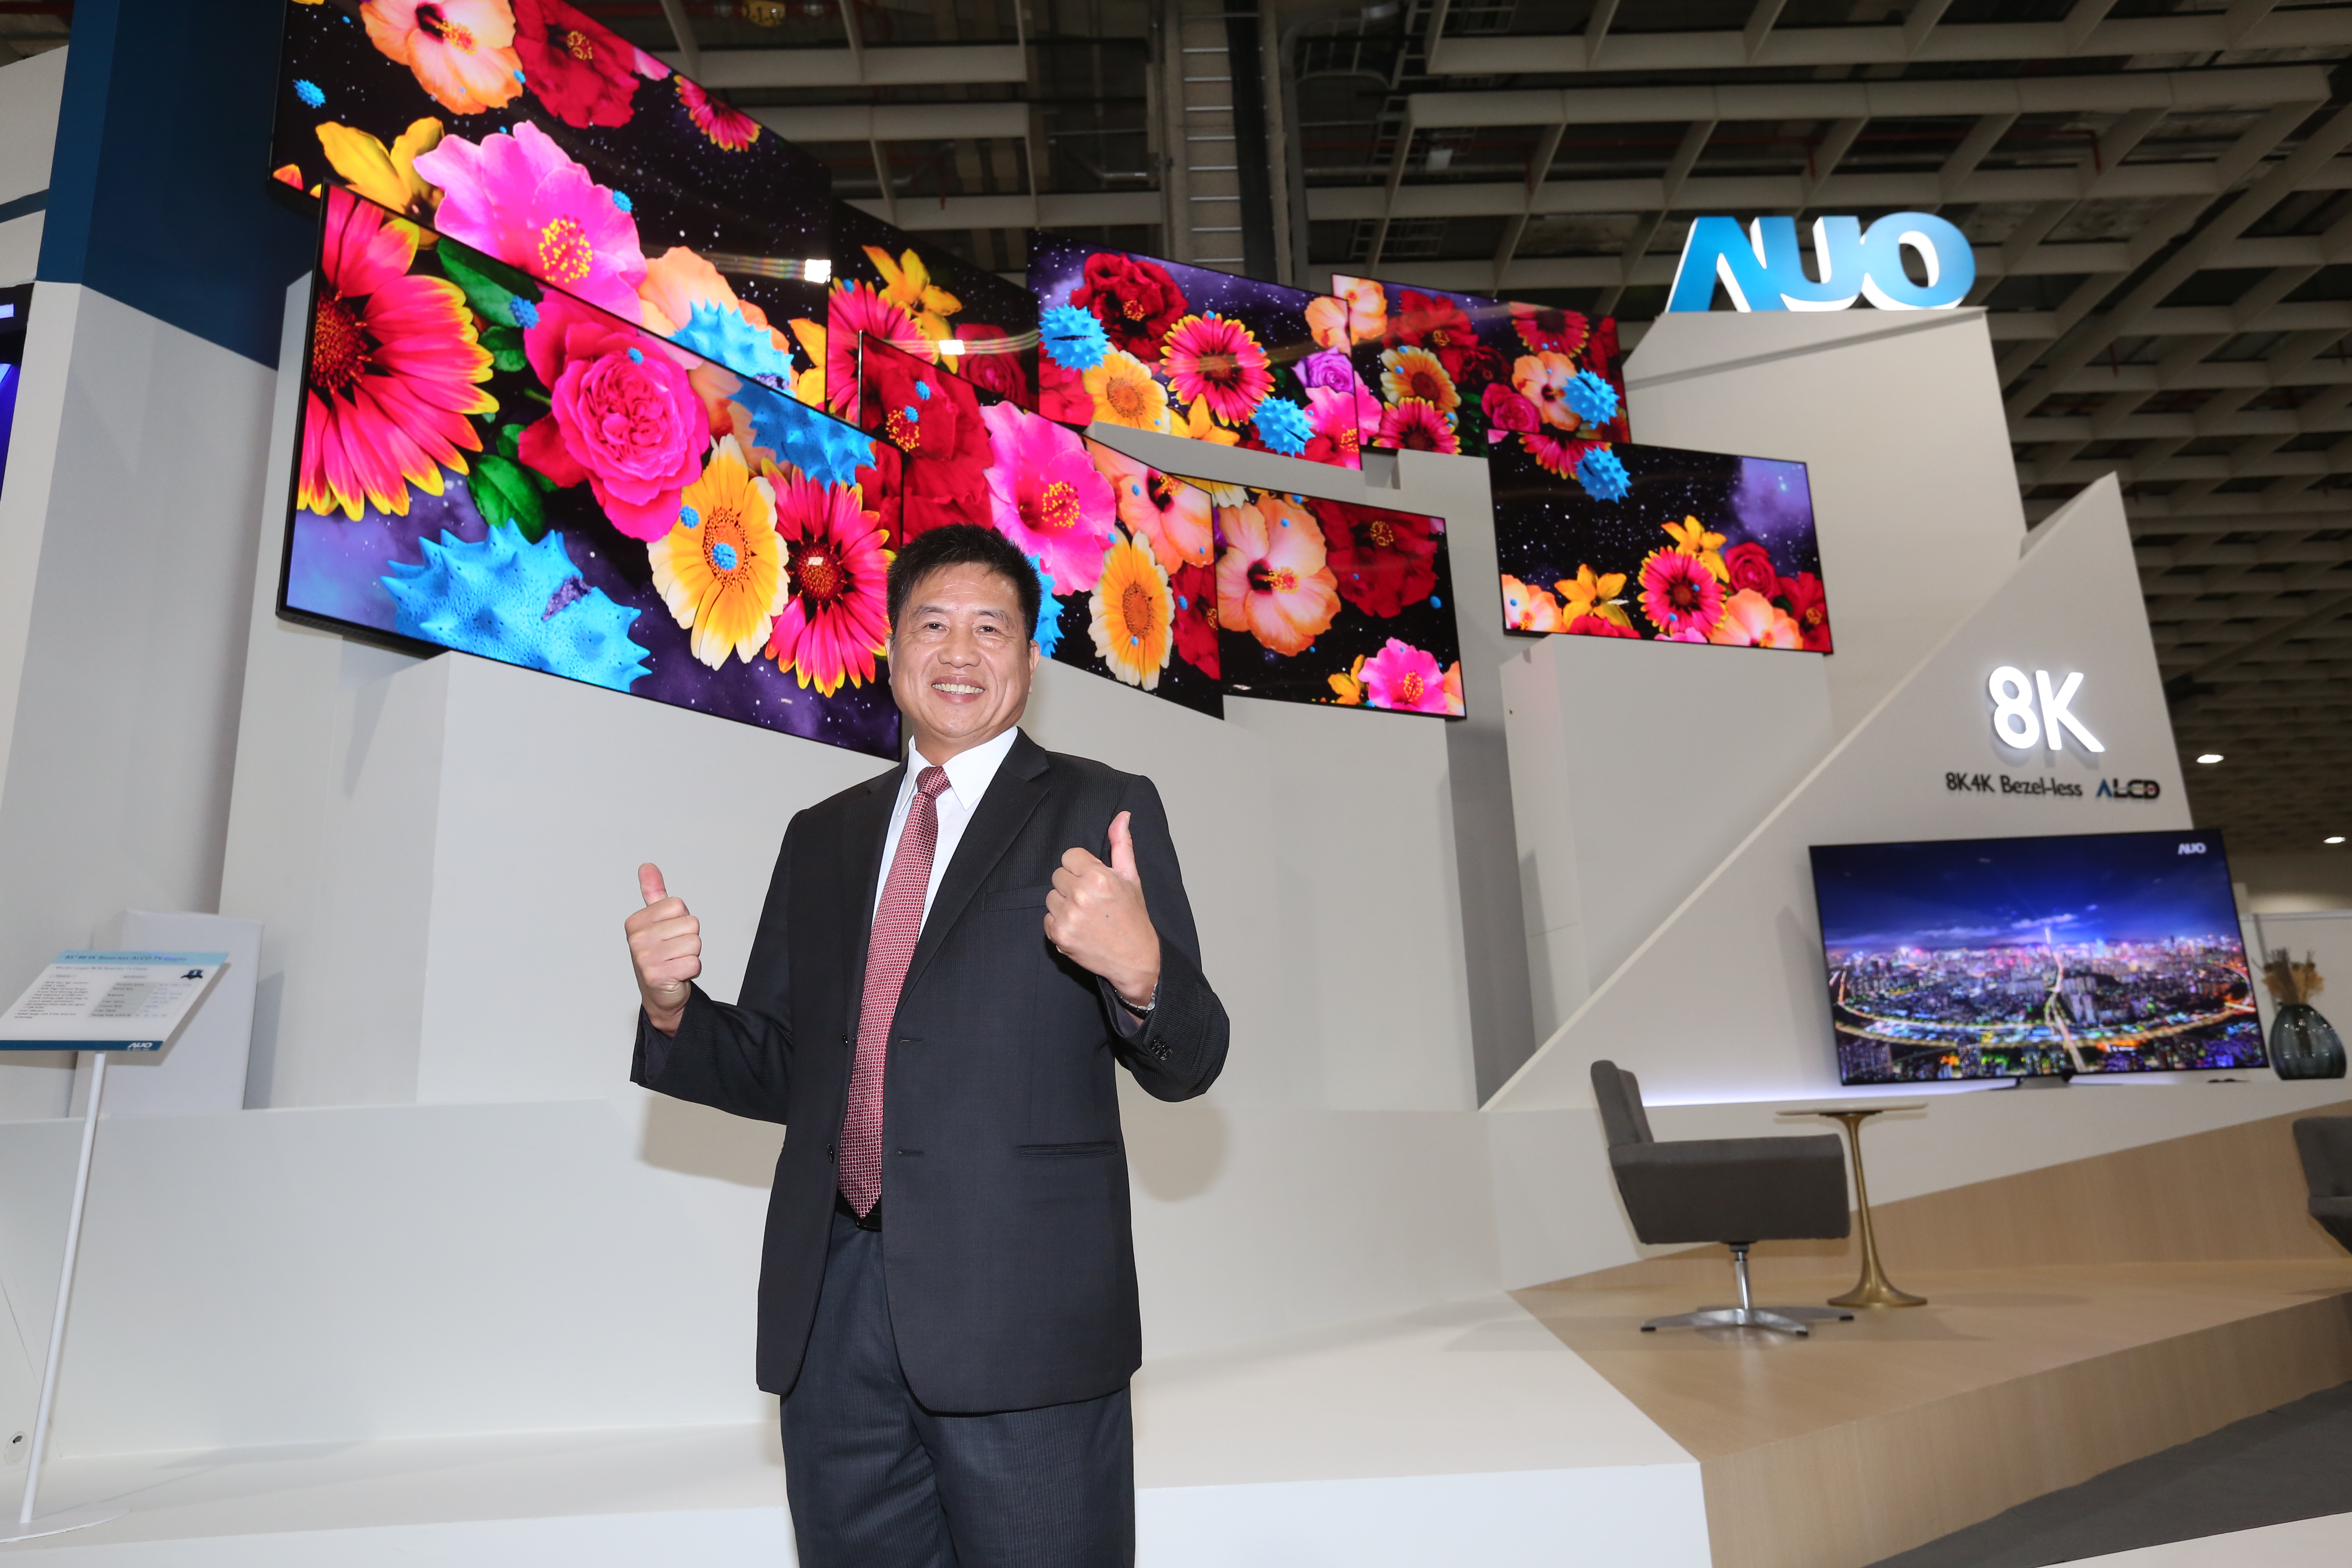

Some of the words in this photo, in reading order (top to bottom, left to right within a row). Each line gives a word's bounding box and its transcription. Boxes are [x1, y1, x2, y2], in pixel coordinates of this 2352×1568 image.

[1664, 212, 1976, 313] AUO
[1989, 666, 2105, 752] 8K
[1946, 772, 1996, 793] 8K4K
[2000, 775, 2082, 797] Bezel-less
[2096, 778, 2160, 800] ALCD
[2178, 842, 2207, 855] AUO
